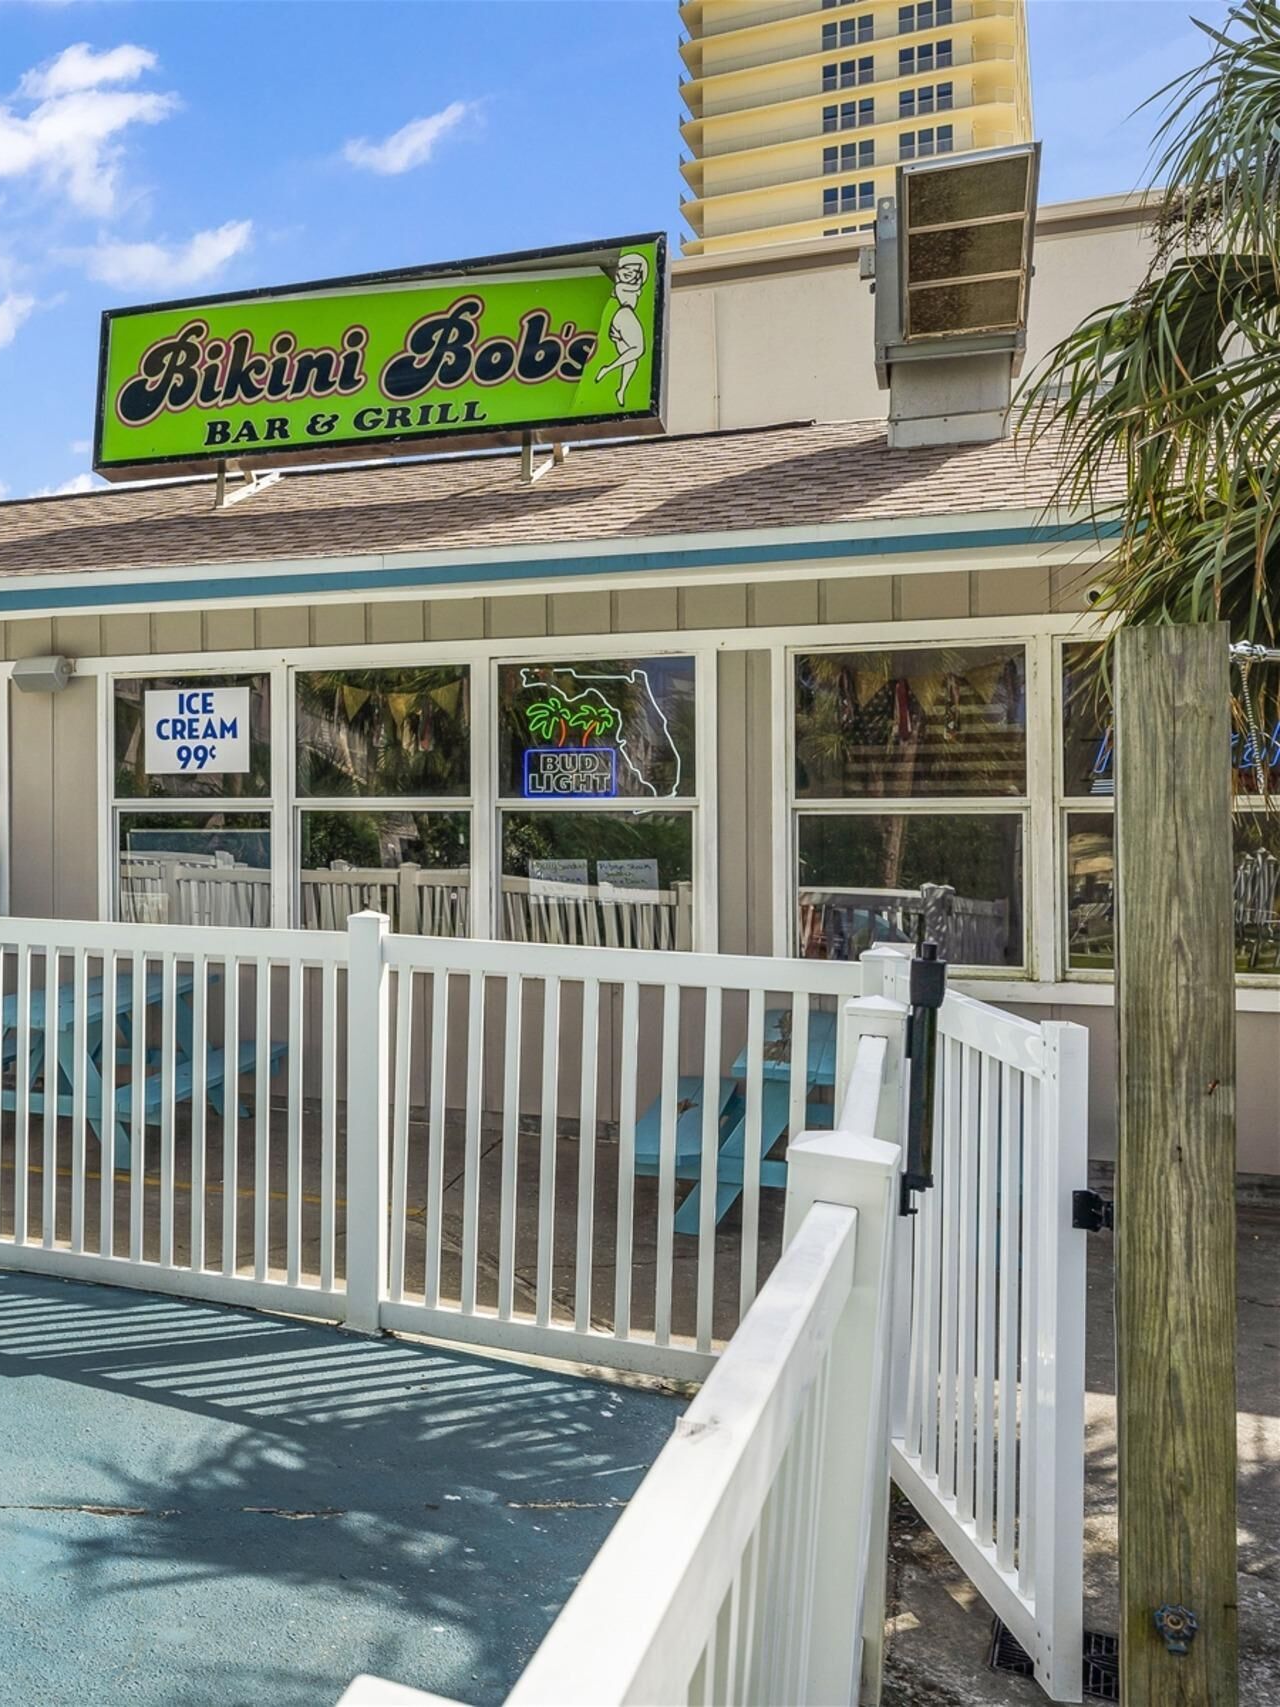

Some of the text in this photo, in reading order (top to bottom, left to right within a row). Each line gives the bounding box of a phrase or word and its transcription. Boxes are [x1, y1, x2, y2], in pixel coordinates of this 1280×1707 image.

[116, 295, 598, 427] Bikini Bob's
[204, 401, 488, 446] BAR & GRILL
[178, 692, 215, 715] ICE
[156, 716, 238, 740] CREAM
[176, 744, 217, 770] 99¢
[540, 753, 600, 773] BUD
[528, 773, 611, 793] LIGHT
